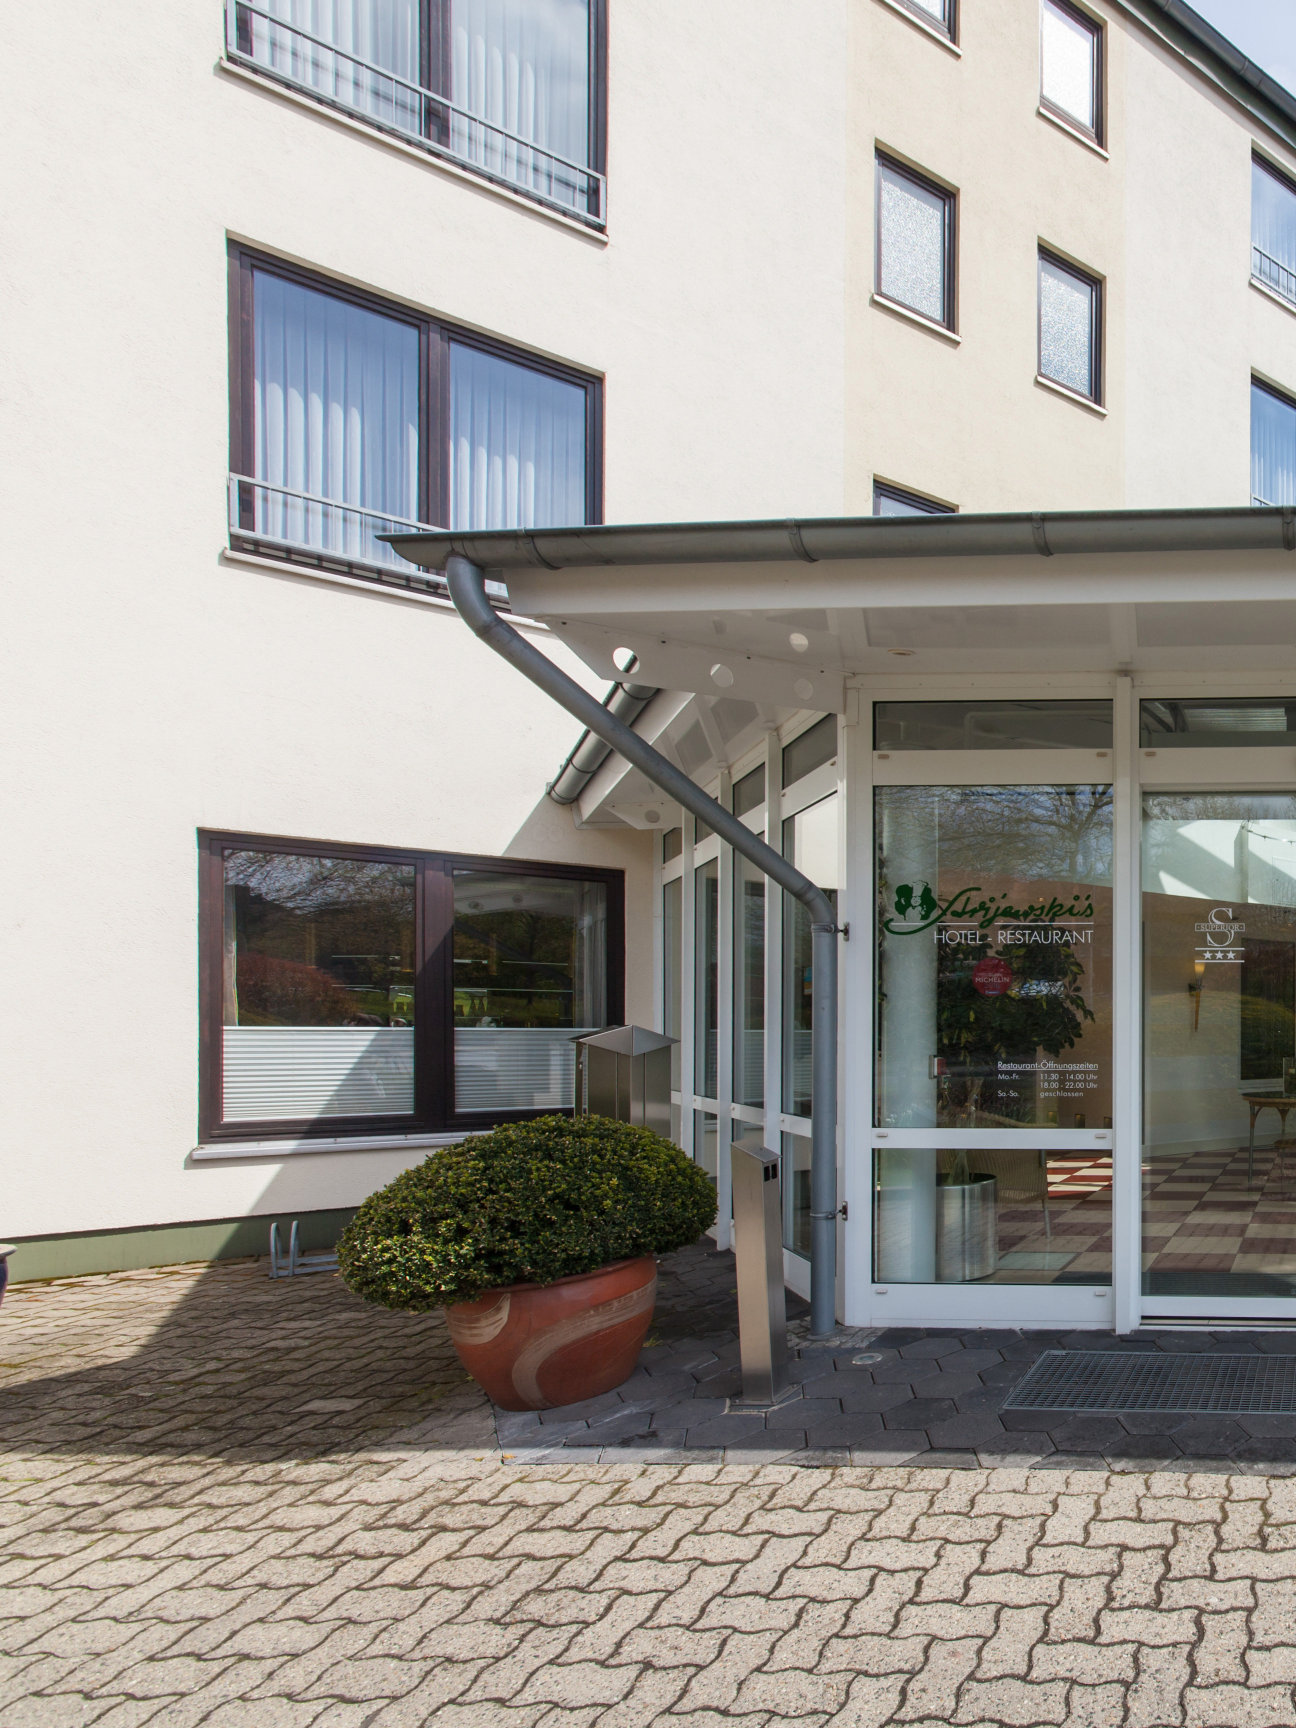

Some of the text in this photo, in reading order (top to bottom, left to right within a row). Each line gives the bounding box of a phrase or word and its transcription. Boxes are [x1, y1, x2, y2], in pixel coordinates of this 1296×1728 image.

[1200, 923, 1240, 931] SUPERIOR
[934, 930, 983, 944] HOTEL
[998, 930, 1094, 944] RESTAURANT
[998, 1060, 1098, 1070] Restaurant-Öffnungszeiten
[1040, 1090, 1084, 1098] geschlossen
